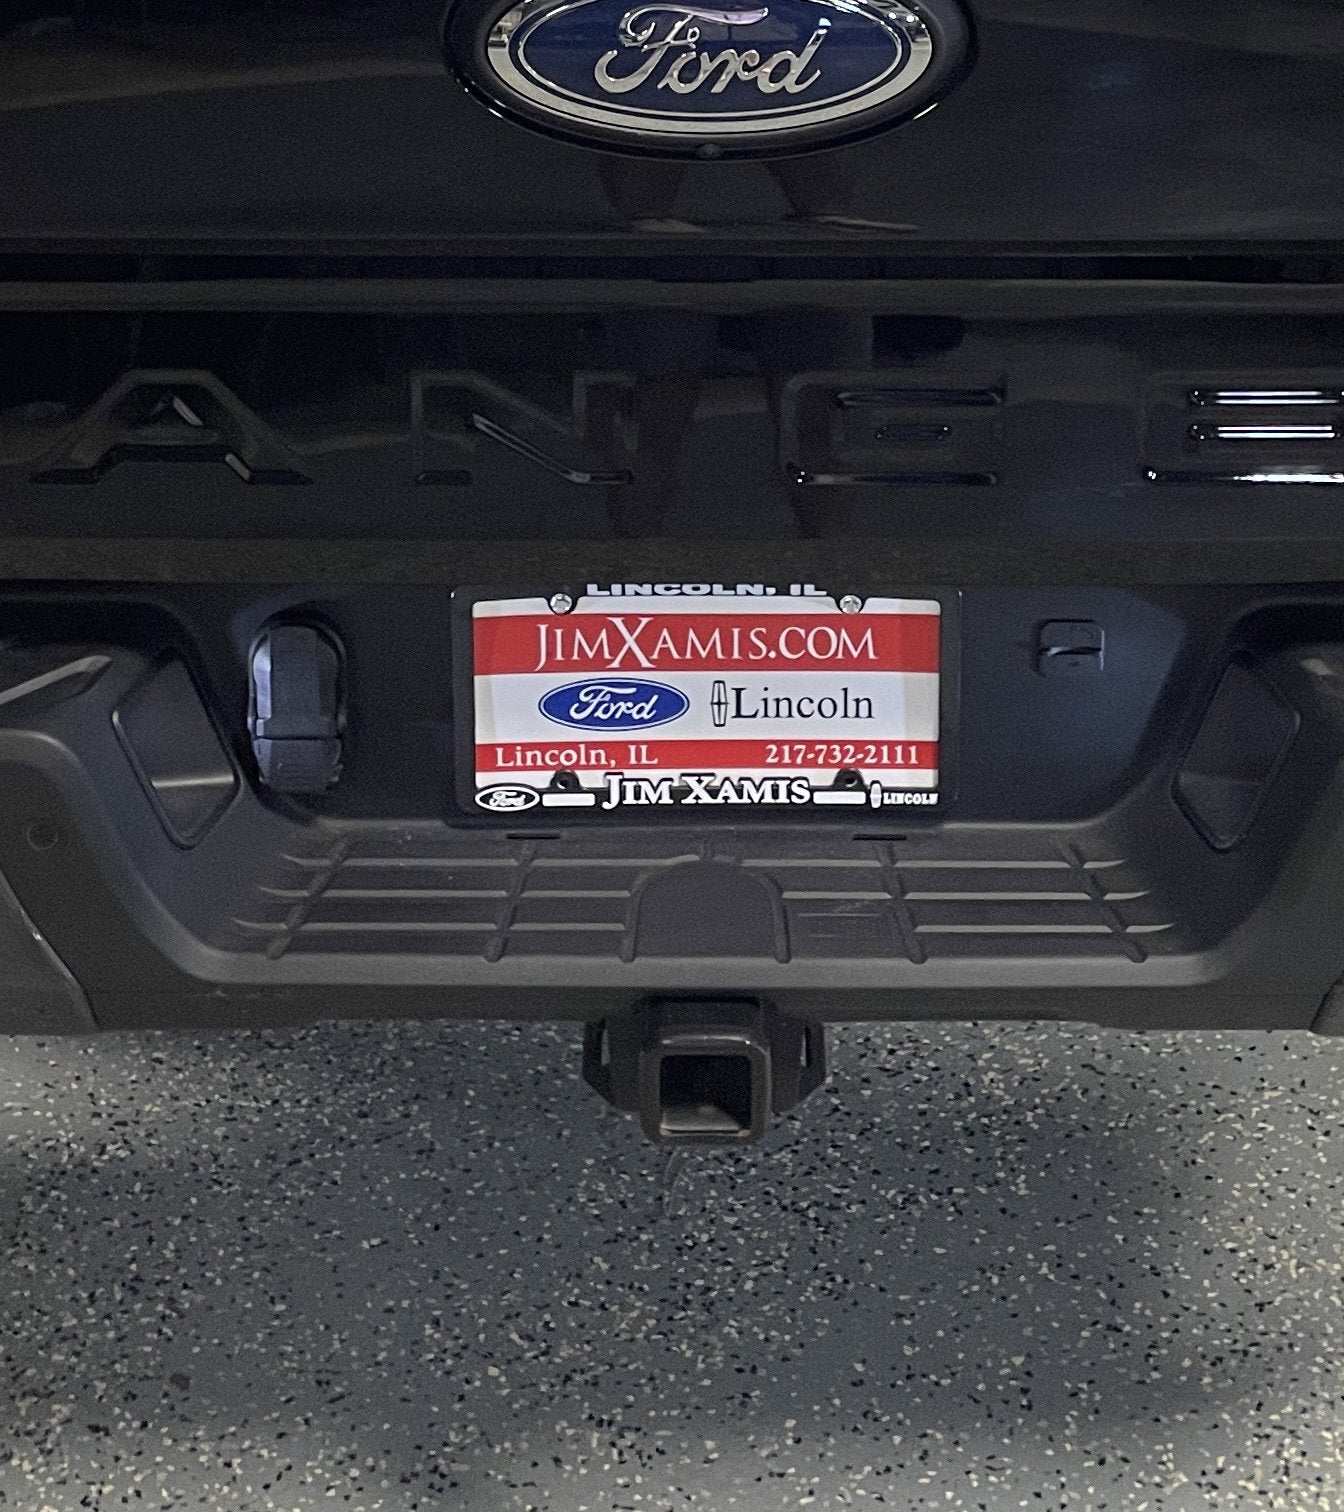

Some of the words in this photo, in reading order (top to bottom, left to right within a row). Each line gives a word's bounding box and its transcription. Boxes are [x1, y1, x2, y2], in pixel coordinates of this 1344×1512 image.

[593, 3, 833, 95] Ford
[586, 583, 777, 596] LINCOLN,
[789, 583, 828, 596] IL
[534, 616, 878, 671] JIMXAMIS.COM
[568, 685, 658, 721] Ford
[730, 687, 876, 720] Lincoln
[495, 745, 617, 769] Lincoln,
[629, 745, 659, 765] IL
[765, 744, 919, 765] 217-732-2111
[488, 790, 527, 808] Ford
[602, 773, 674, 810] JIM
[680, 773, 811, 804] XAMIS
[882, 792, 939, 806] LINCOLN
